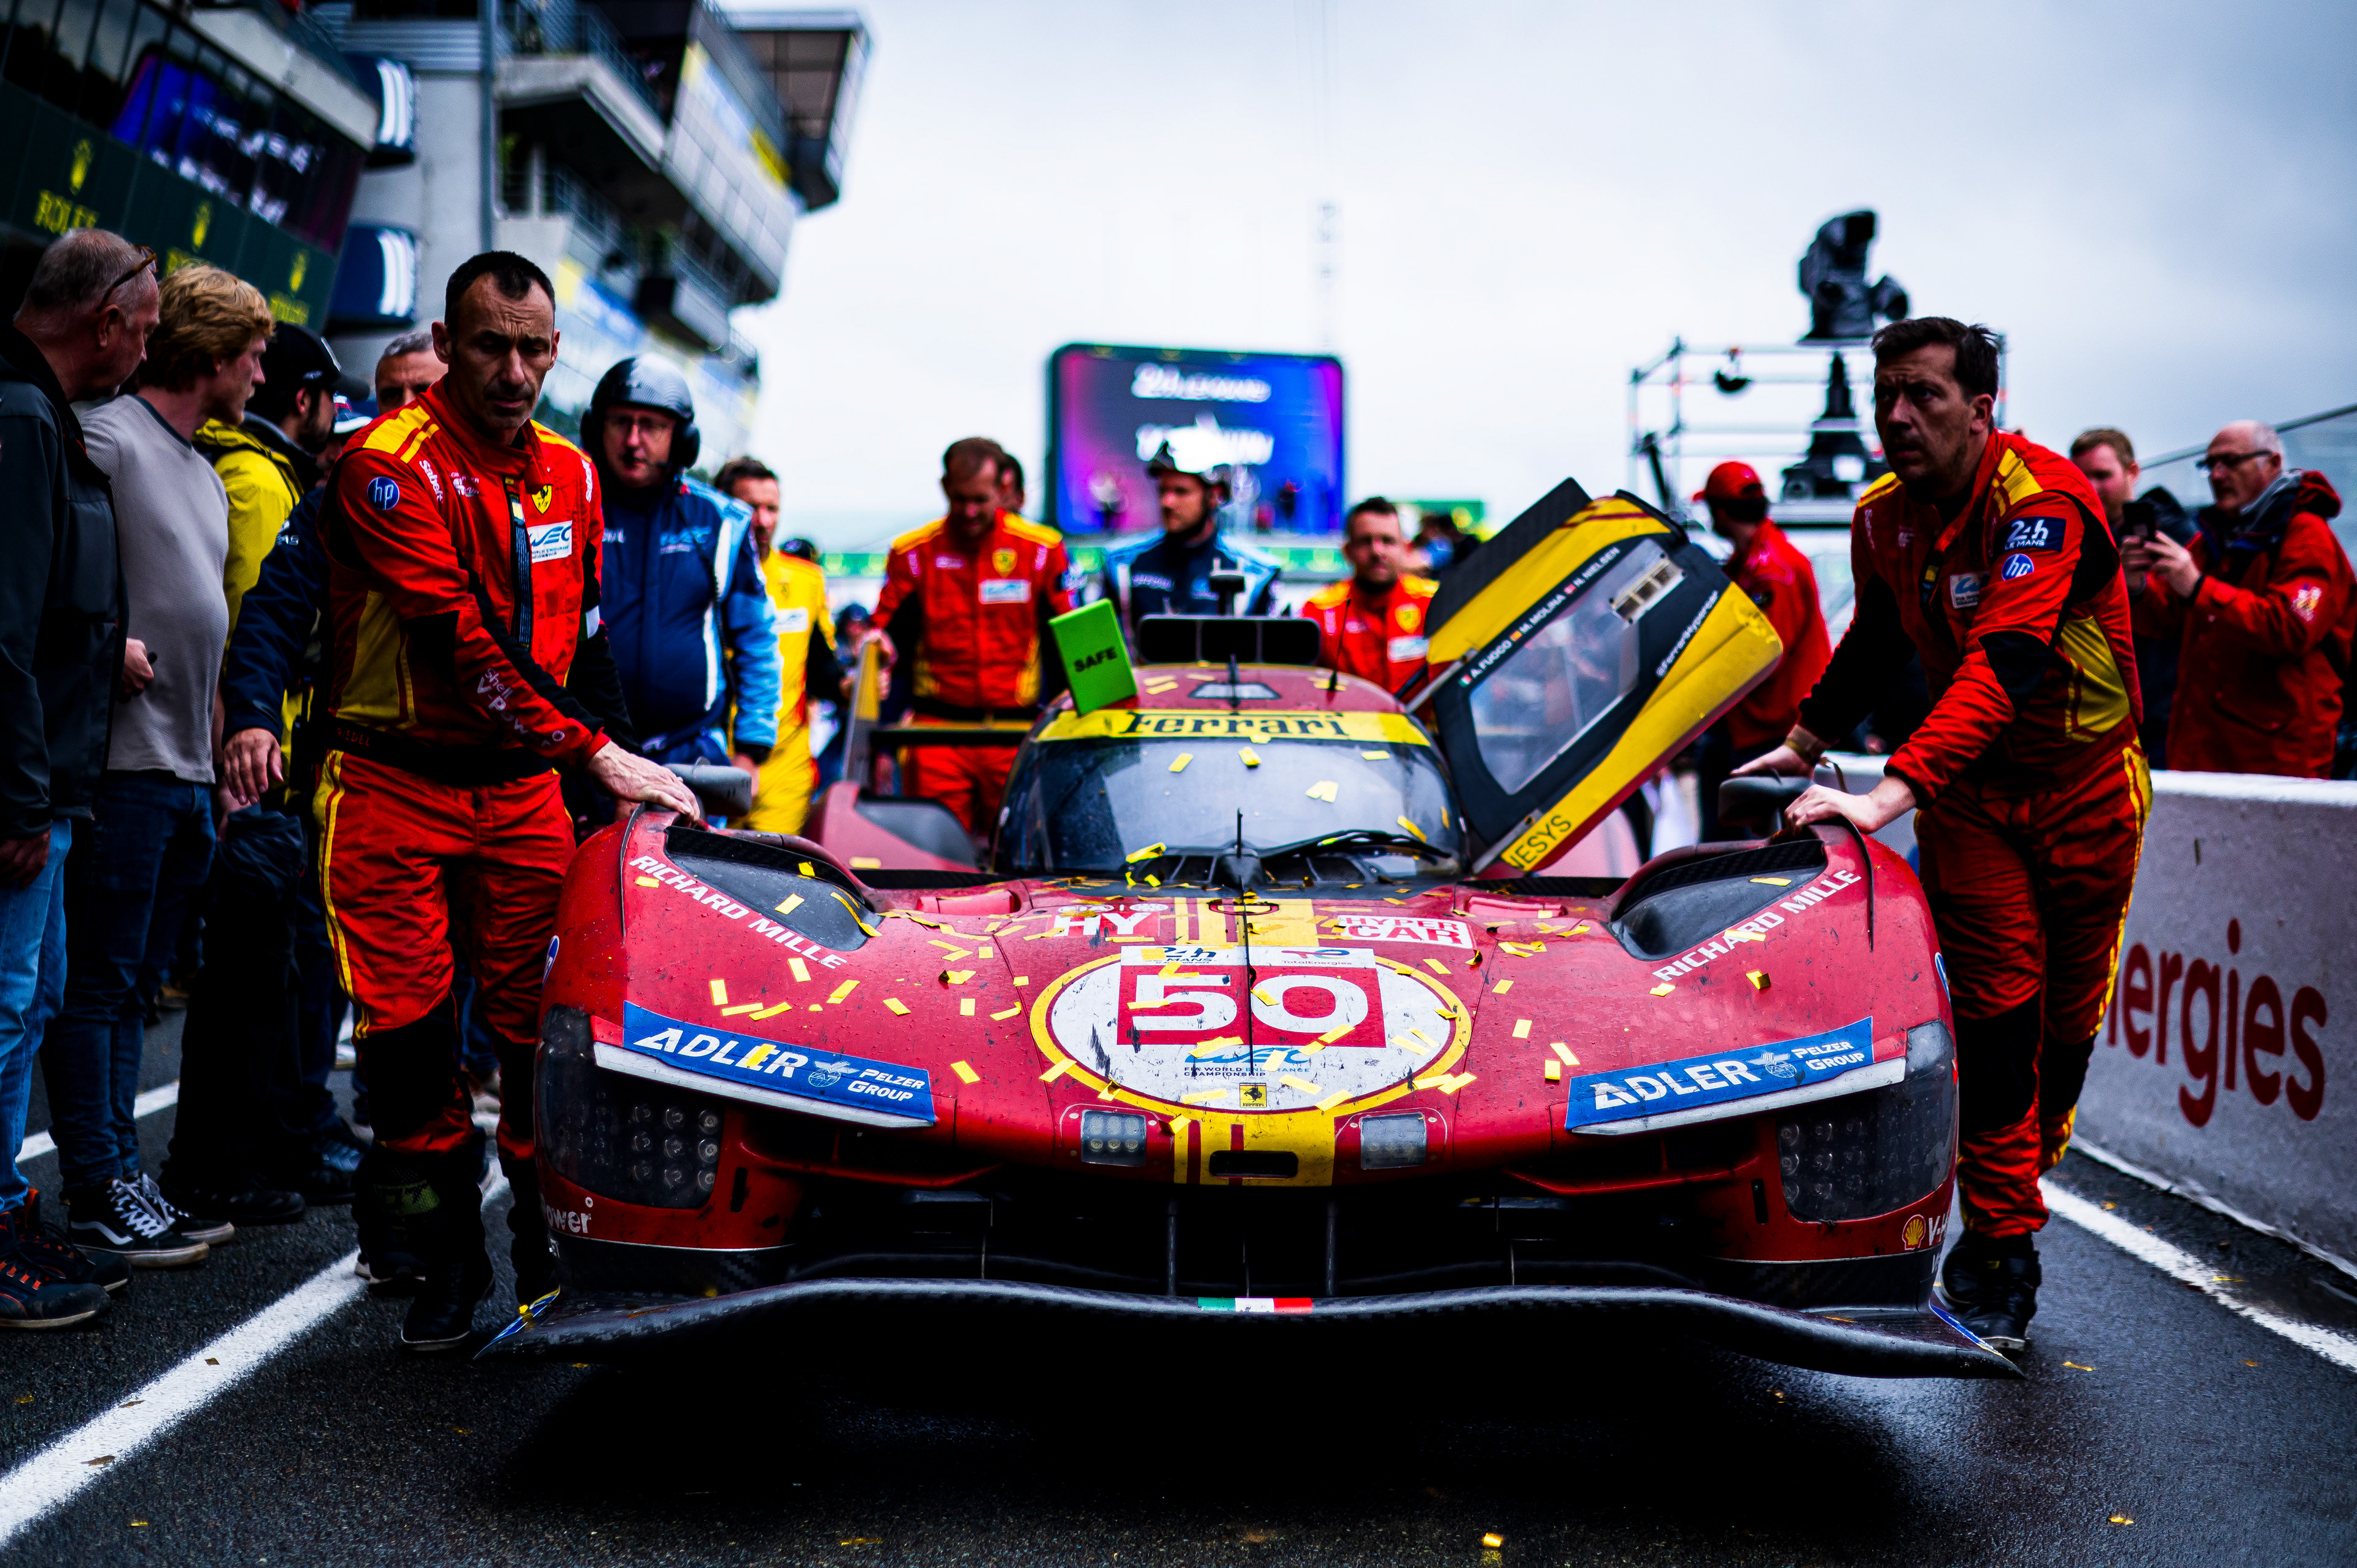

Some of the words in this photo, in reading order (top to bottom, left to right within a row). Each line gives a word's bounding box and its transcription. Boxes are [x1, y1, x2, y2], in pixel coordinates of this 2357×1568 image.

[373, 477, 394, 510] hp
[2017, 539, 2045, 548] MANS
[1479, 639, 1512, 670] FUOCO
[1529, 593, 1566, 625] MOLINA
[1074, 646, 1118, 673] SAFE
[485, 668, 514, 700] Shell
[476, 676, 552, 747] V-Powr
[1118, 711, 1350, 736] Ferrari
[629, 855, 750, 919] RICHARD
[748, 917, 847, 970] MILLE
[1053, 912, 1152, 937] HY
[1345, 917, 1459, 931] HYPER
[1652, 911, 1785, 982] RICHARD
[1779, 870, 1862, 914] MILLE
[1347, 925, 1463, 945] CAR
[1132, 974, 1369, 1033] 50
[633, 1027, 808, 1078] ADLER
[1790, 1041, 1855, 1059] PELZER
[1805, 1052, 1865, 1071] GROUP
[848, 1081, 915, 1102] GROUP
[859, 1068, 926, 1090] PELZER
[1589, 1060, 1762, 1110] ADLER
